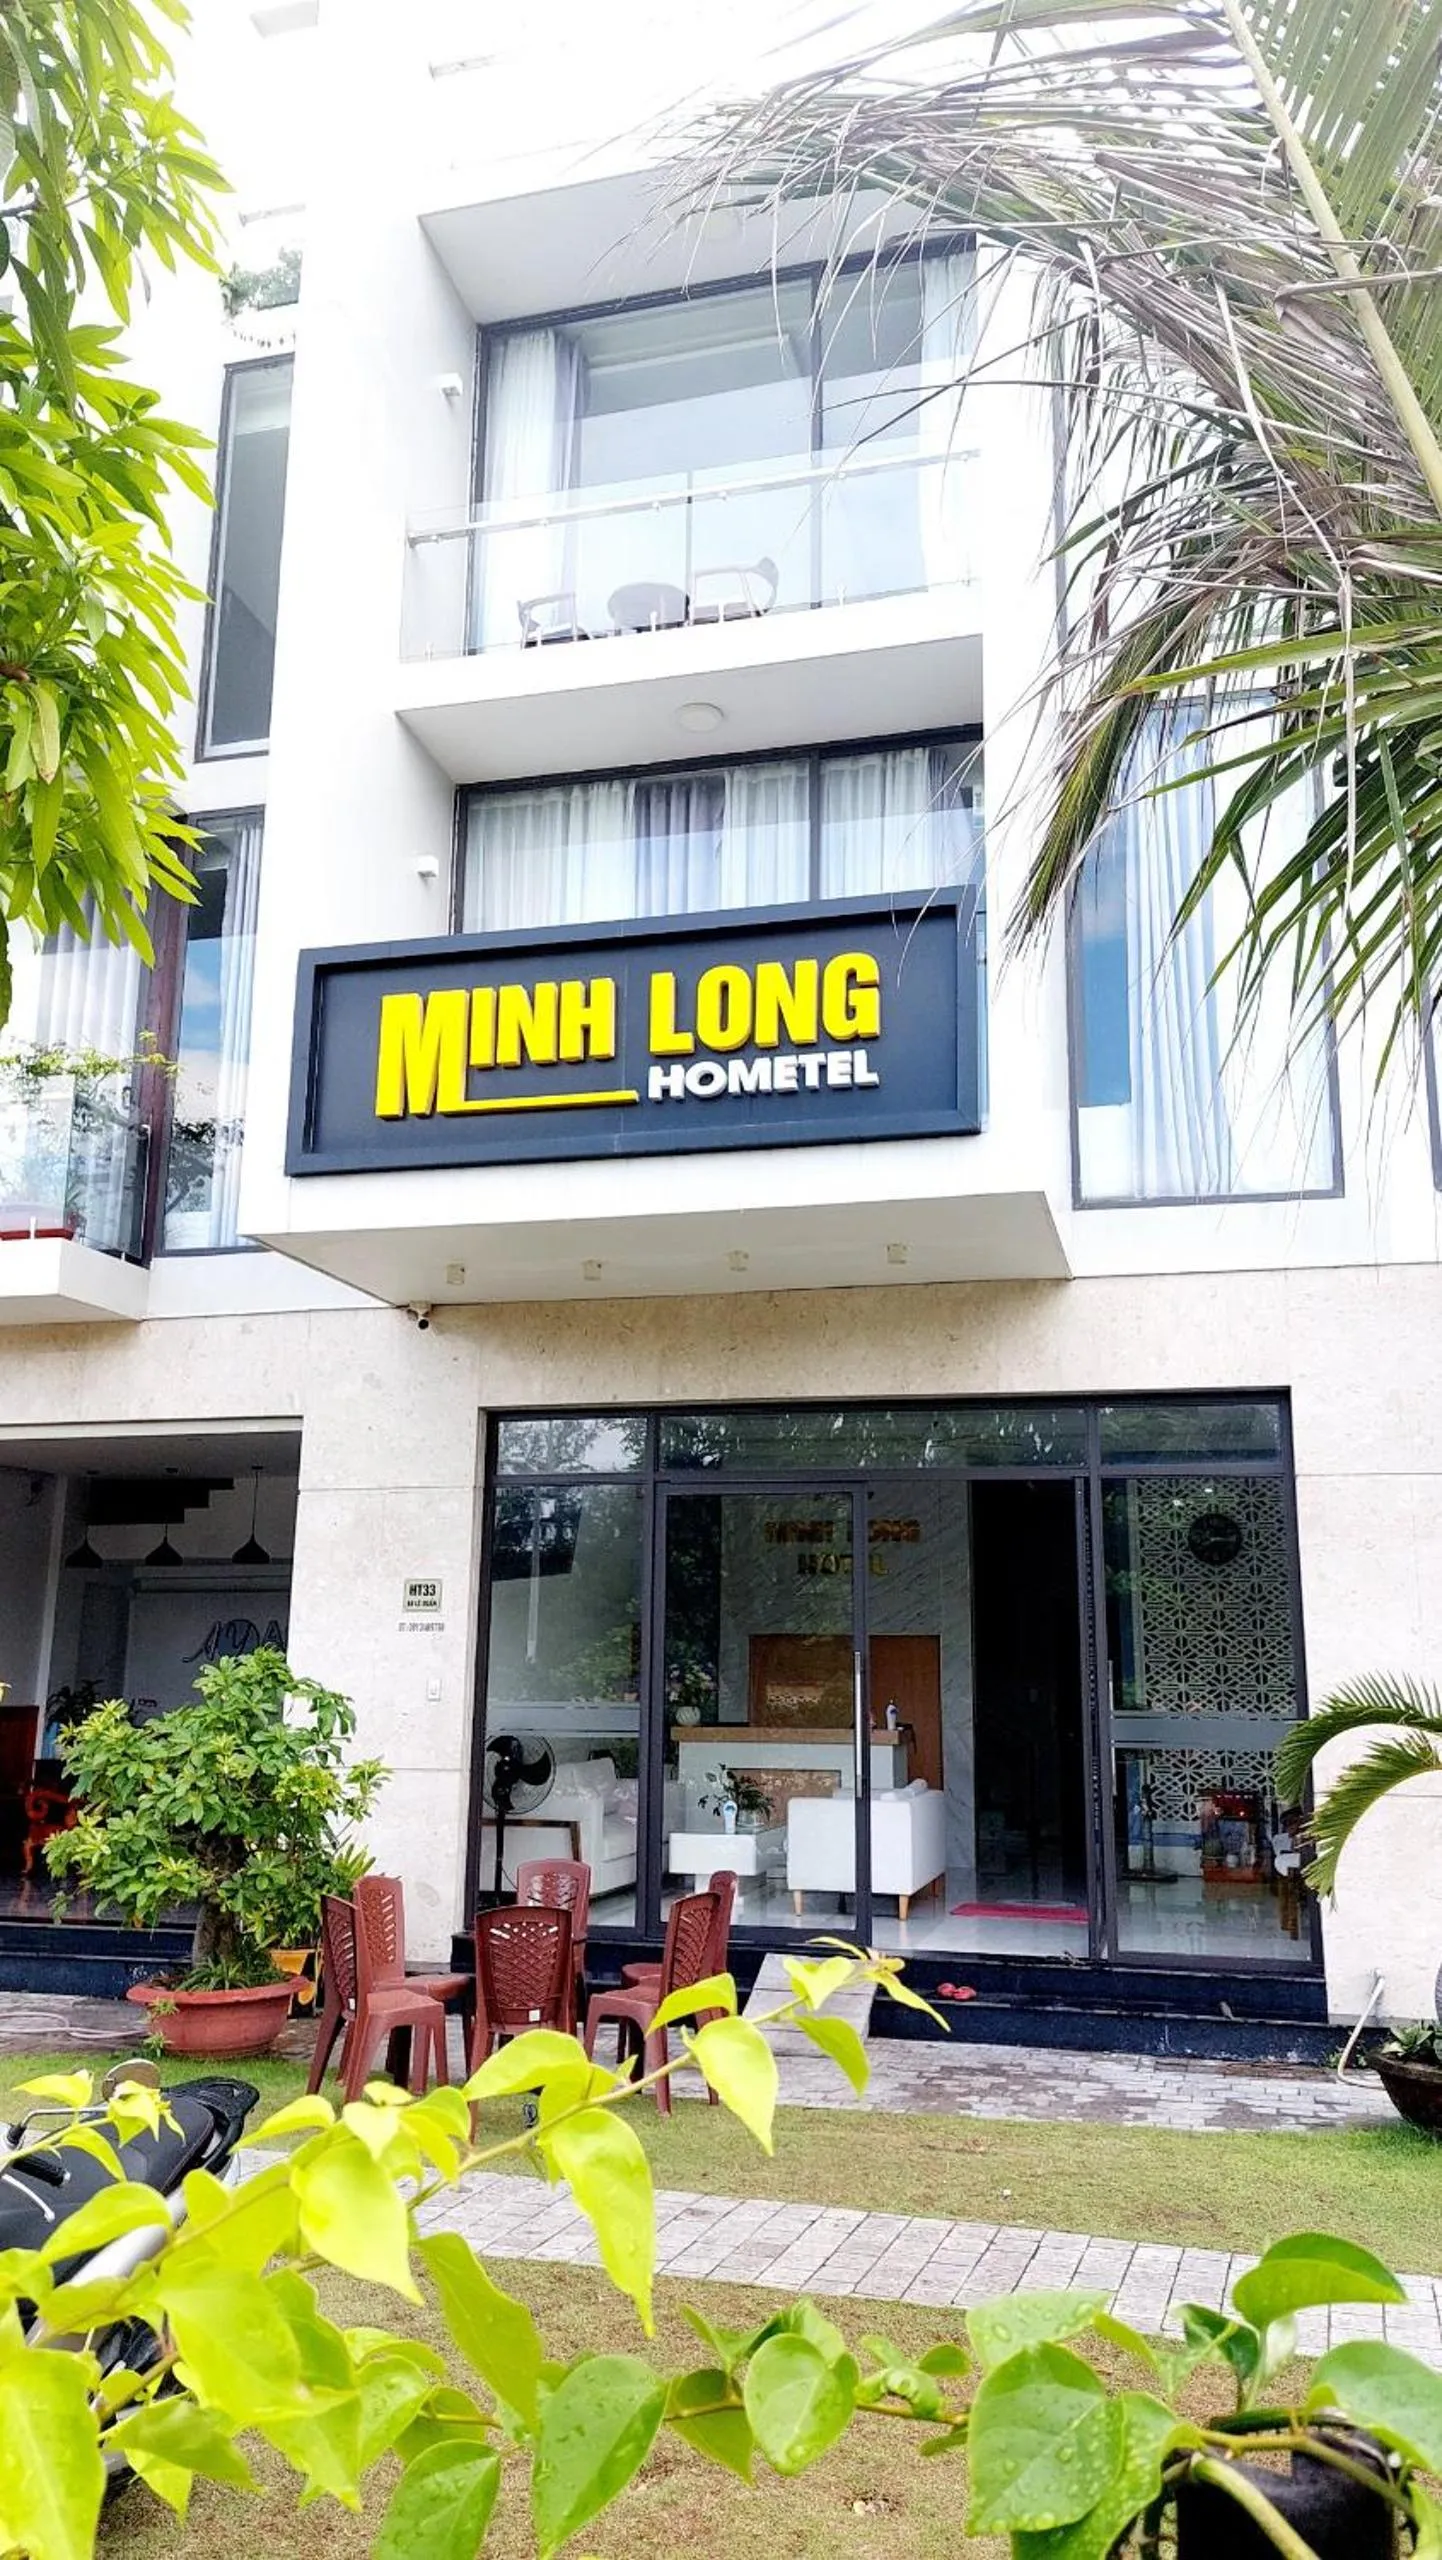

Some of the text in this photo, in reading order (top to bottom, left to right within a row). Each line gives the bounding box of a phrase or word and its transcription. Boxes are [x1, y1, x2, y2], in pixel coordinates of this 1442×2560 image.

[375, 952, 882, 1119] MINH LONG
[647, 1048, 880, 1101] HOMETEL
[797, 1553, 889, 1577] HOTL
[409, 1583, 436, 1597] HT33
